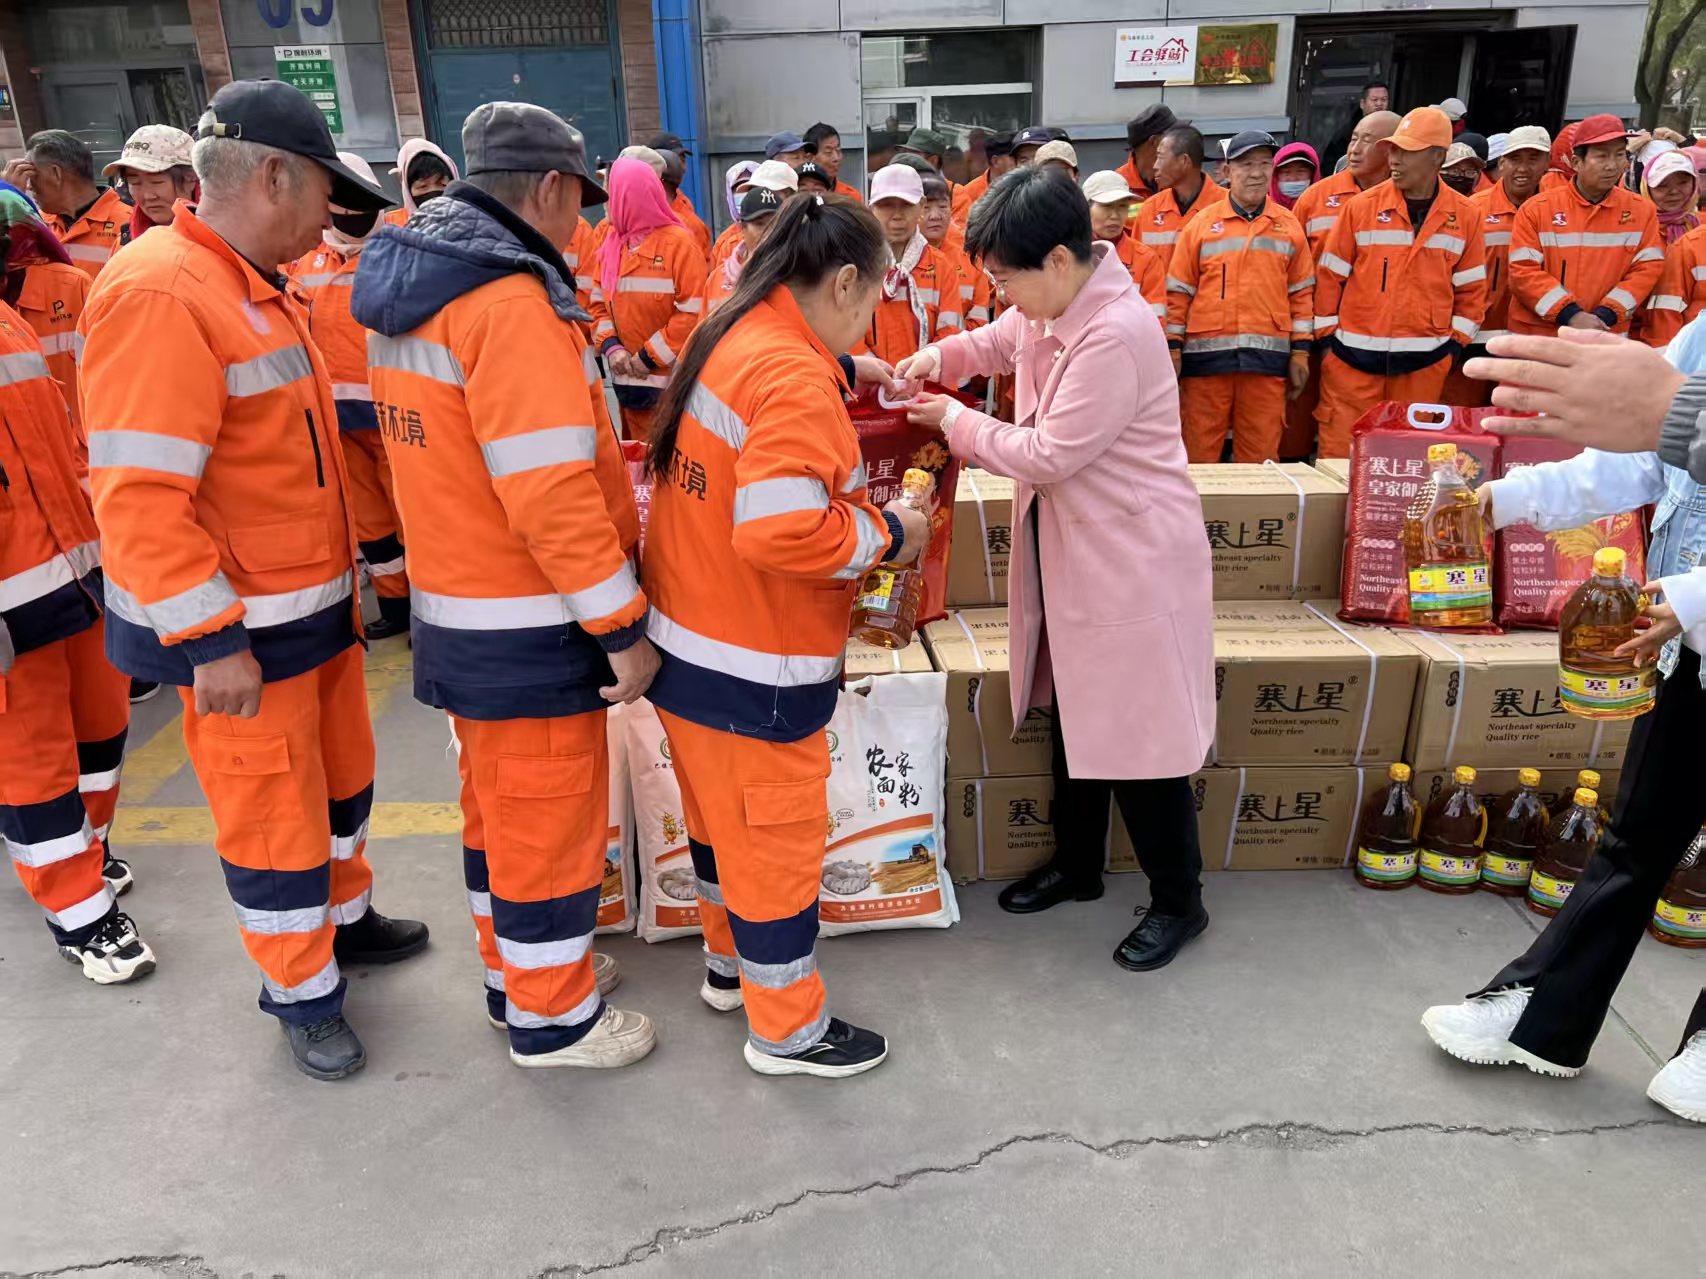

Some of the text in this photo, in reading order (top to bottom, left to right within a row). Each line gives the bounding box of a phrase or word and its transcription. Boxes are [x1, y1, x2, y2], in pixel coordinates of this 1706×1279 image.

[1127, 47, 1181, 62] 工会驿站
[761, 189, 776, 204] NY
[1369, 456, 1426, 479] 塞上星
[1205, 518, 1290, 549] 塞上星
[1243, 554, 1282, 562] specialty
[1360, 574, 1406, 584] Northeast
[1513, 578, 1559, 587] Northeast
[1359, 584, 1392, 593] Quality
[1514, 587, 1568, 598] Quality rice
[1253, 682, 1350, 713] 塞上星
[1251, 717, 1340, 727] Northeast specialty
[1488, 721, 1577, 732] Northeast specialty
[1250, 727, 1285, 736] Quality
[1012, 735, 1045, 744] Quality
[1486, 733, 1540, 742] Quality rice
[866, 744, 914, 778] 农家
[877, 776, 923, 809] 面粉
[1237, 791, 1329, 822] 塞上星
[1008, 798, 1042, 826] 塞
[1234, 826, 1320, 836] Northeast specialty
[1007, 840, 1041, 850] Quality
[1233, 837, 1285, 846] Quality rice
